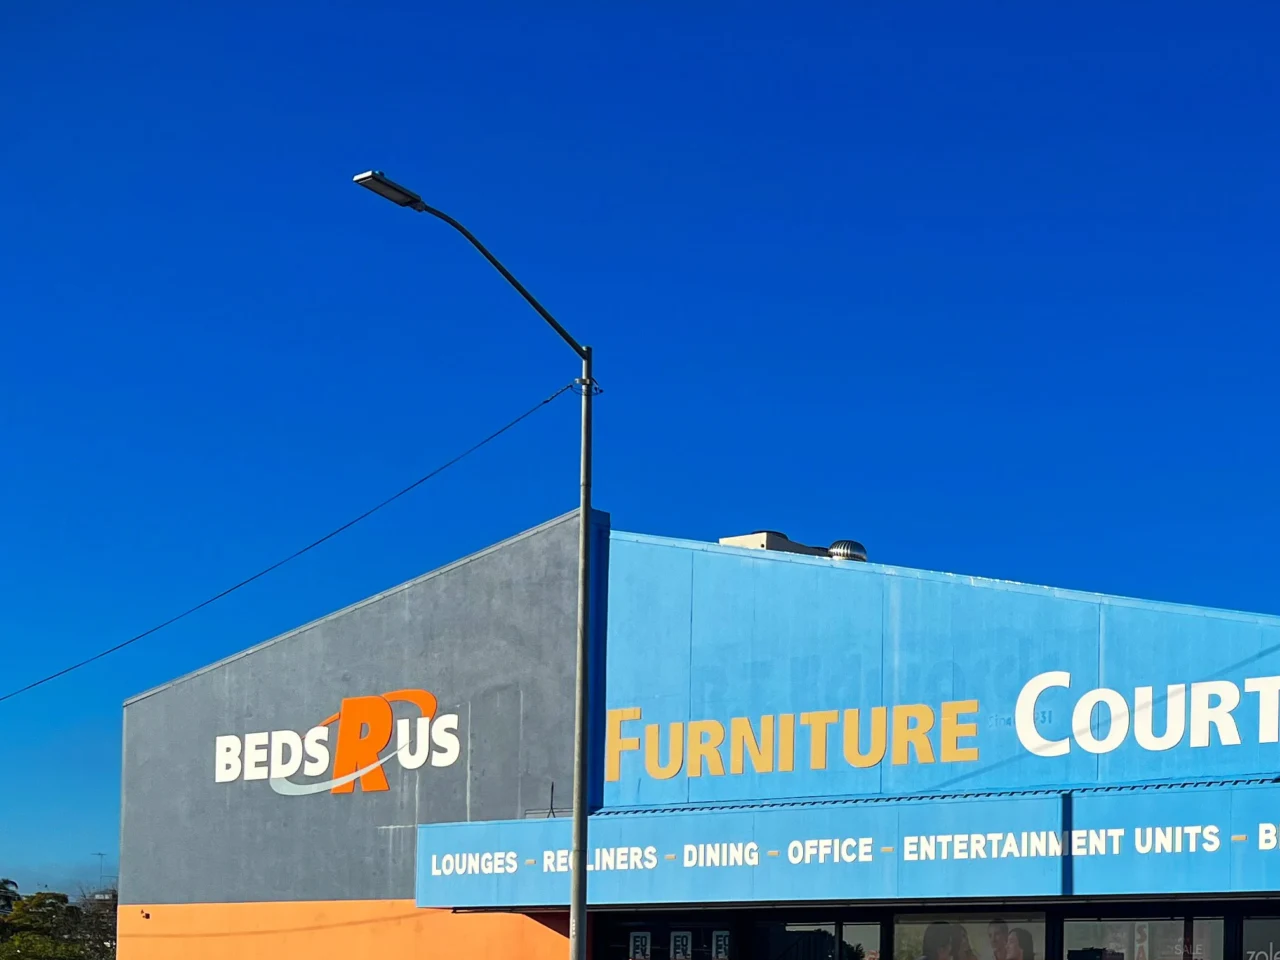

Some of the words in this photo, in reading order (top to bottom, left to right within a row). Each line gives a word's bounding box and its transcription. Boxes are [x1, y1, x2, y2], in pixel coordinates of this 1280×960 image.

[215, 726, 329, 783] BEDS
[331, 695, 393, 794] R
[397, 713, 461, 770] US
[604, 700, 979, 782] FURNITURE
[431, 851, 517, 876] LOUNGES
[683, 842, 760, 869] DINING
[788, 837, 873, 865] OFFICE
[903, 828, 1124, 862] ENTERTAINMENT
[1135, 825, 1221, 854] UNITS
